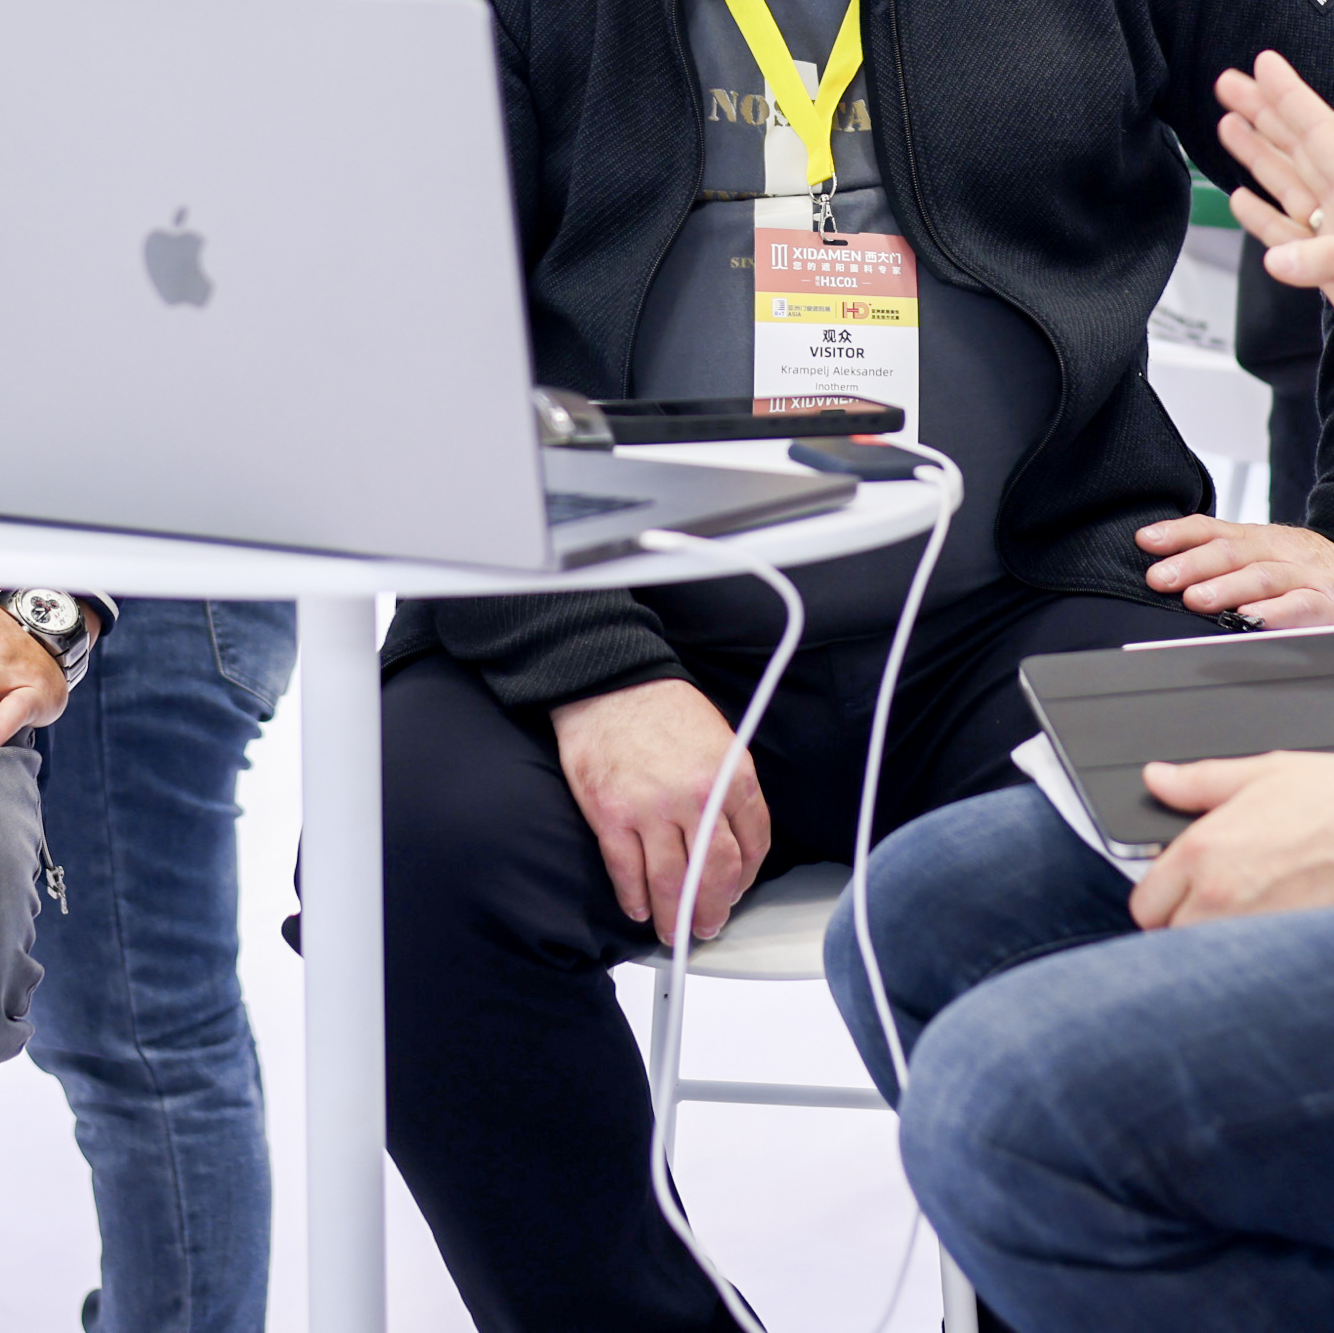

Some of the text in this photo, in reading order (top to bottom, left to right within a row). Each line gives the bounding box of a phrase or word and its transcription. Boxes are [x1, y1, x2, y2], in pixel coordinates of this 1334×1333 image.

[793, 247, 902, 264] XIDAMEN 西大门
[793, 261, 902, 275] 您的遮阳面料专家
[820, 275, 858, 288] H1C01
[822, 329, 852, 343] 观众
[810, 346, 865, 358] VISITOR
[781, 365, 894, 377] Krampelj Aleksander
[815, 382, 858, 391] Inotherm
